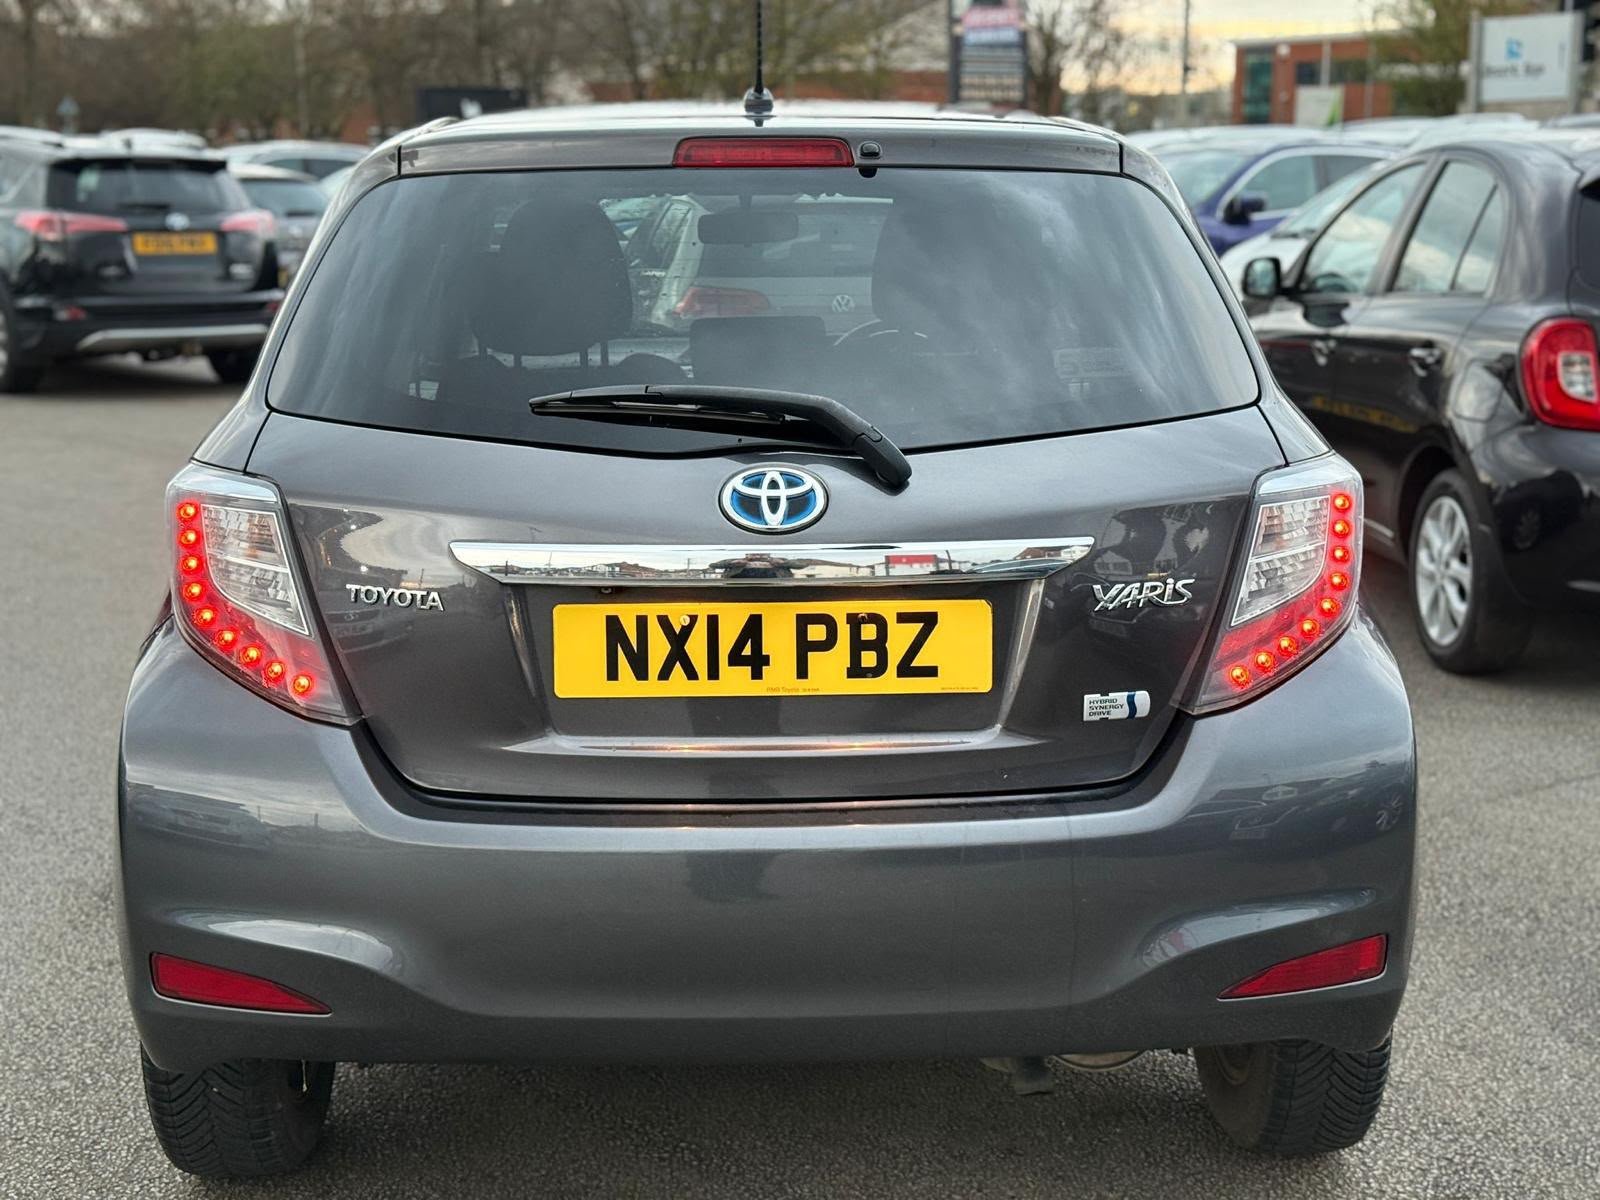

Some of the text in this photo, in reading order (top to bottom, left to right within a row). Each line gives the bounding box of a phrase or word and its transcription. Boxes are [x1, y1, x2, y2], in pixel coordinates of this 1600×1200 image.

[346, 583, 444, 611] TOYOTA
[606, 612, 938, 680] NX14 PBZ
